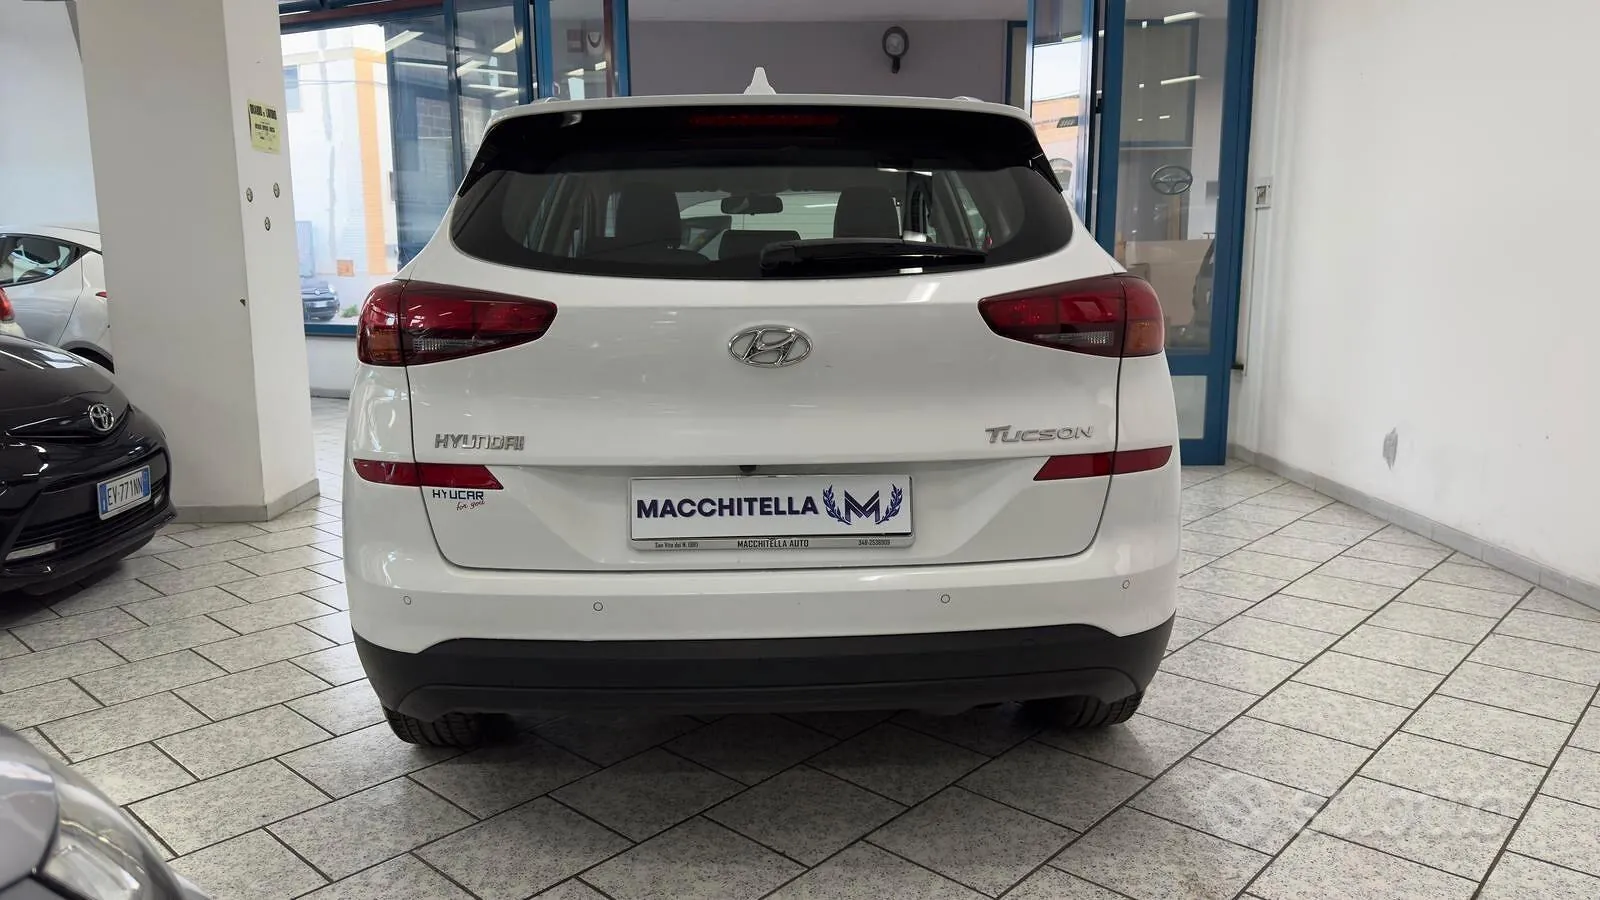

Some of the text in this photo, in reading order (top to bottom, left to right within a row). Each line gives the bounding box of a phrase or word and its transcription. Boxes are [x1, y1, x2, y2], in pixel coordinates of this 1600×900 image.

[435, 433, 525, 451] HYUNDAI
[985, 425, 1094, 444] TUCSON
[432, 489, 484, 500] HYUCAR
[636, 496, 819, 518] MACCHITELLA
[737, 539, 809, 548] MACCHITELLA AUTO
